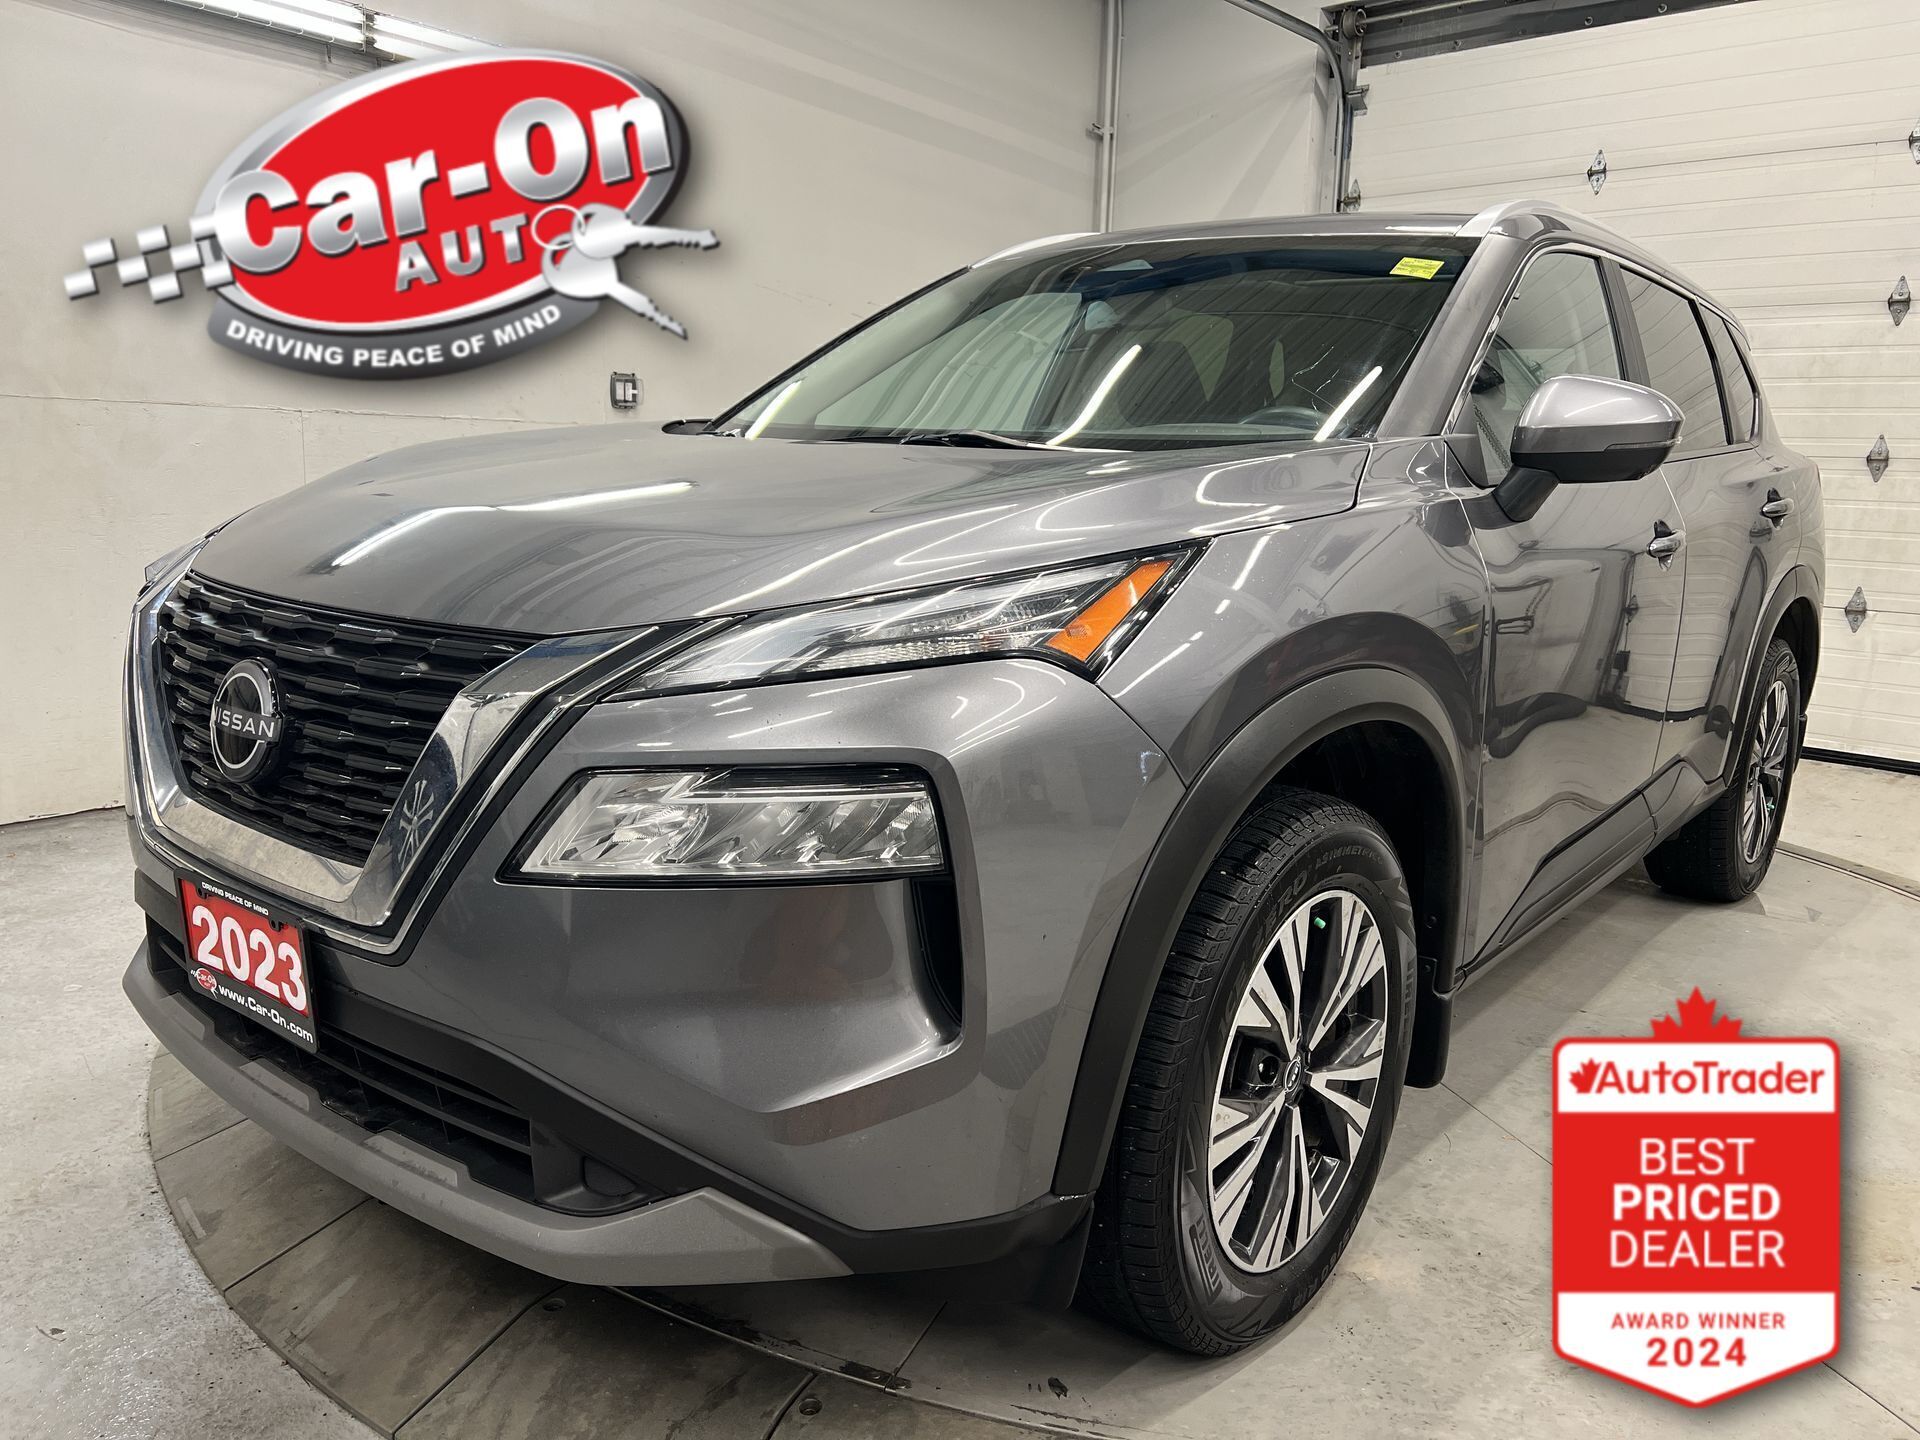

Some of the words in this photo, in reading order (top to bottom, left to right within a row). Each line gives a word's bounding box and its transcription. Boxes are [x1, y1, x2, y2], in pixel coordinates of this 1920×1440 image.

[201, 881, 225, 897] DRIVING
[224, 891, 244, 905] PEACE
[243, 899, 253, 908] OF
[252, 903, 269, 916] MIND
[1252, 868, 1309, 963] ZERO
[192, 905, 307, 1011] 2023
[218, 984, 314, 1044] www.Car-On.com
[1189, 1213, 1223, 1306] PIRELLI
